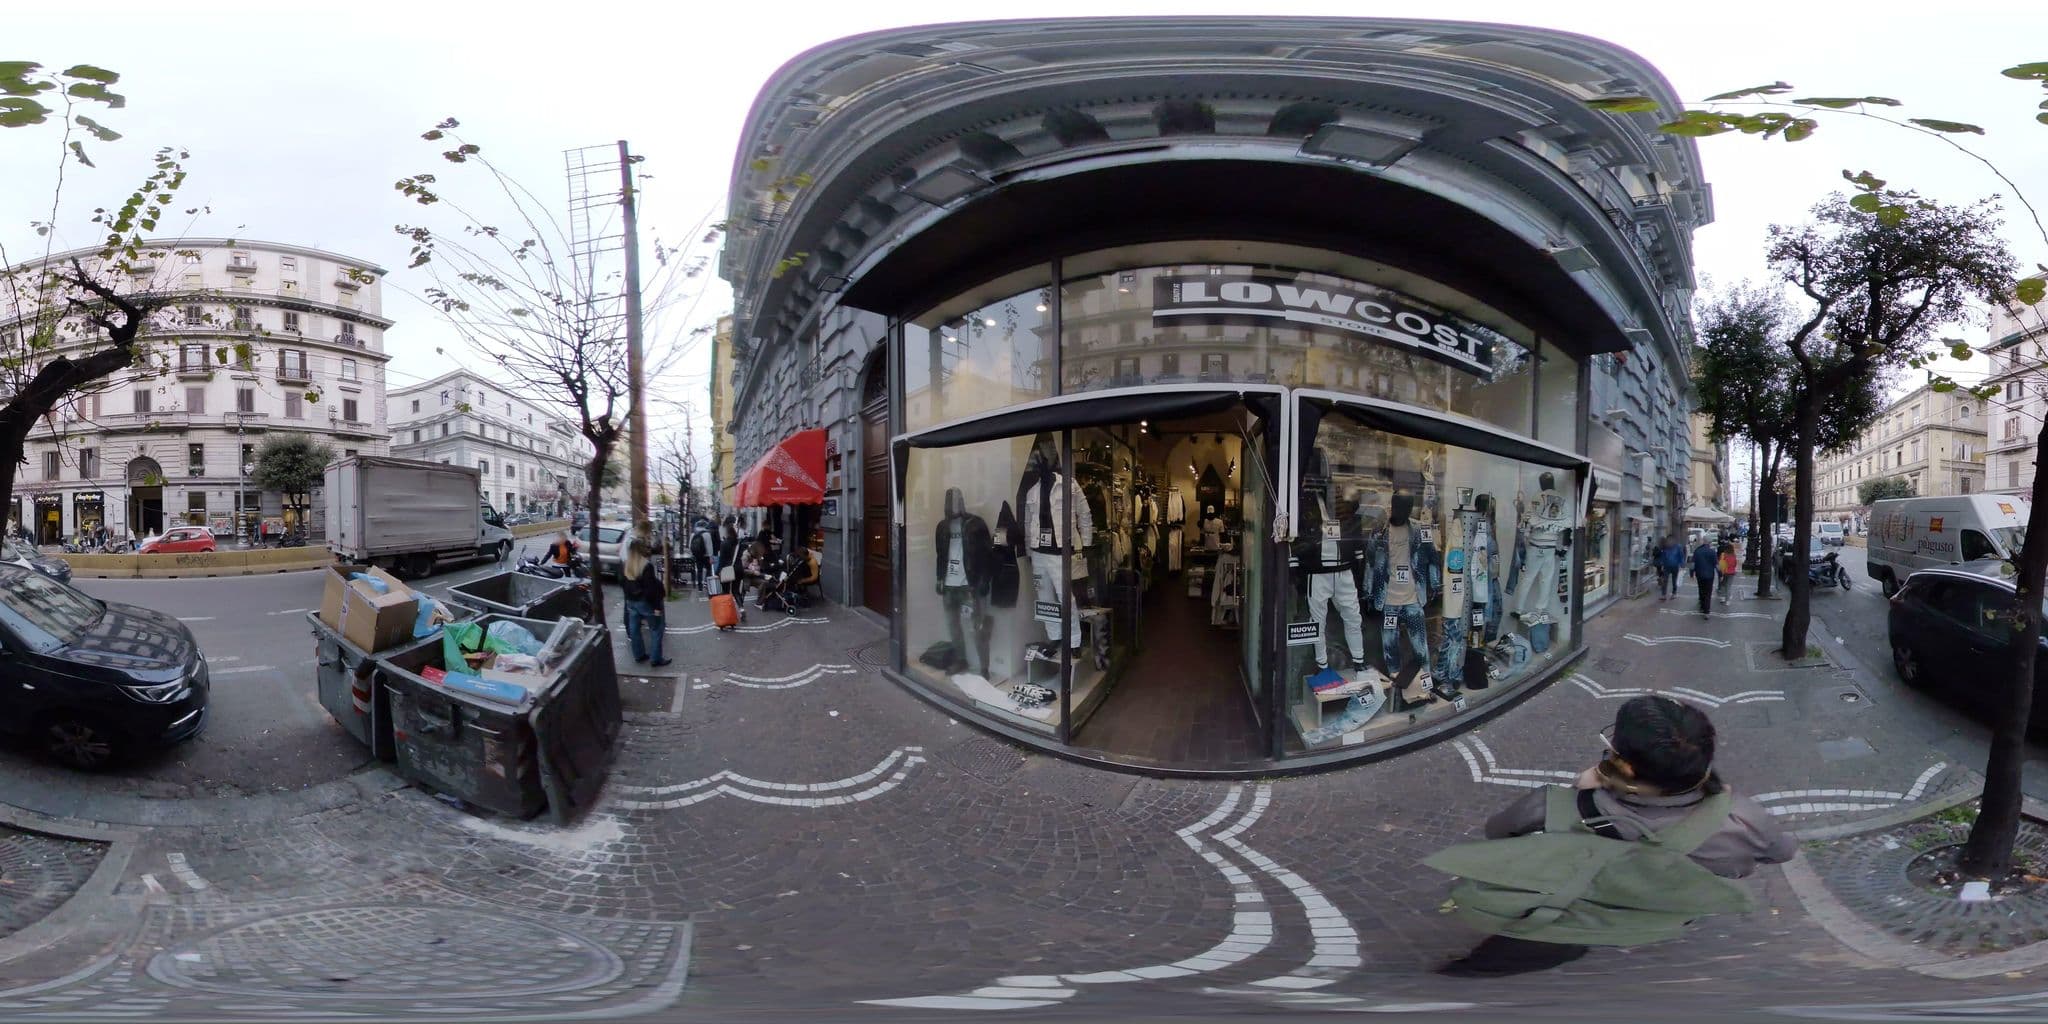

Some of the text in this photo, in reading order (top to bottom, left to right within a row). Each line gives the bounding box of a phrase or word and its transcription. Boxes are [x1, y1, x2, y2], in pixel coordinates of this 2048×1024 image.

[1321, 316, 1387, 336] STORE
[1037, 604, 1060, 612] NUOVA
[1385, 616, 1394, 626] 24
[1290, 625, 1317, 634] NUOVA
